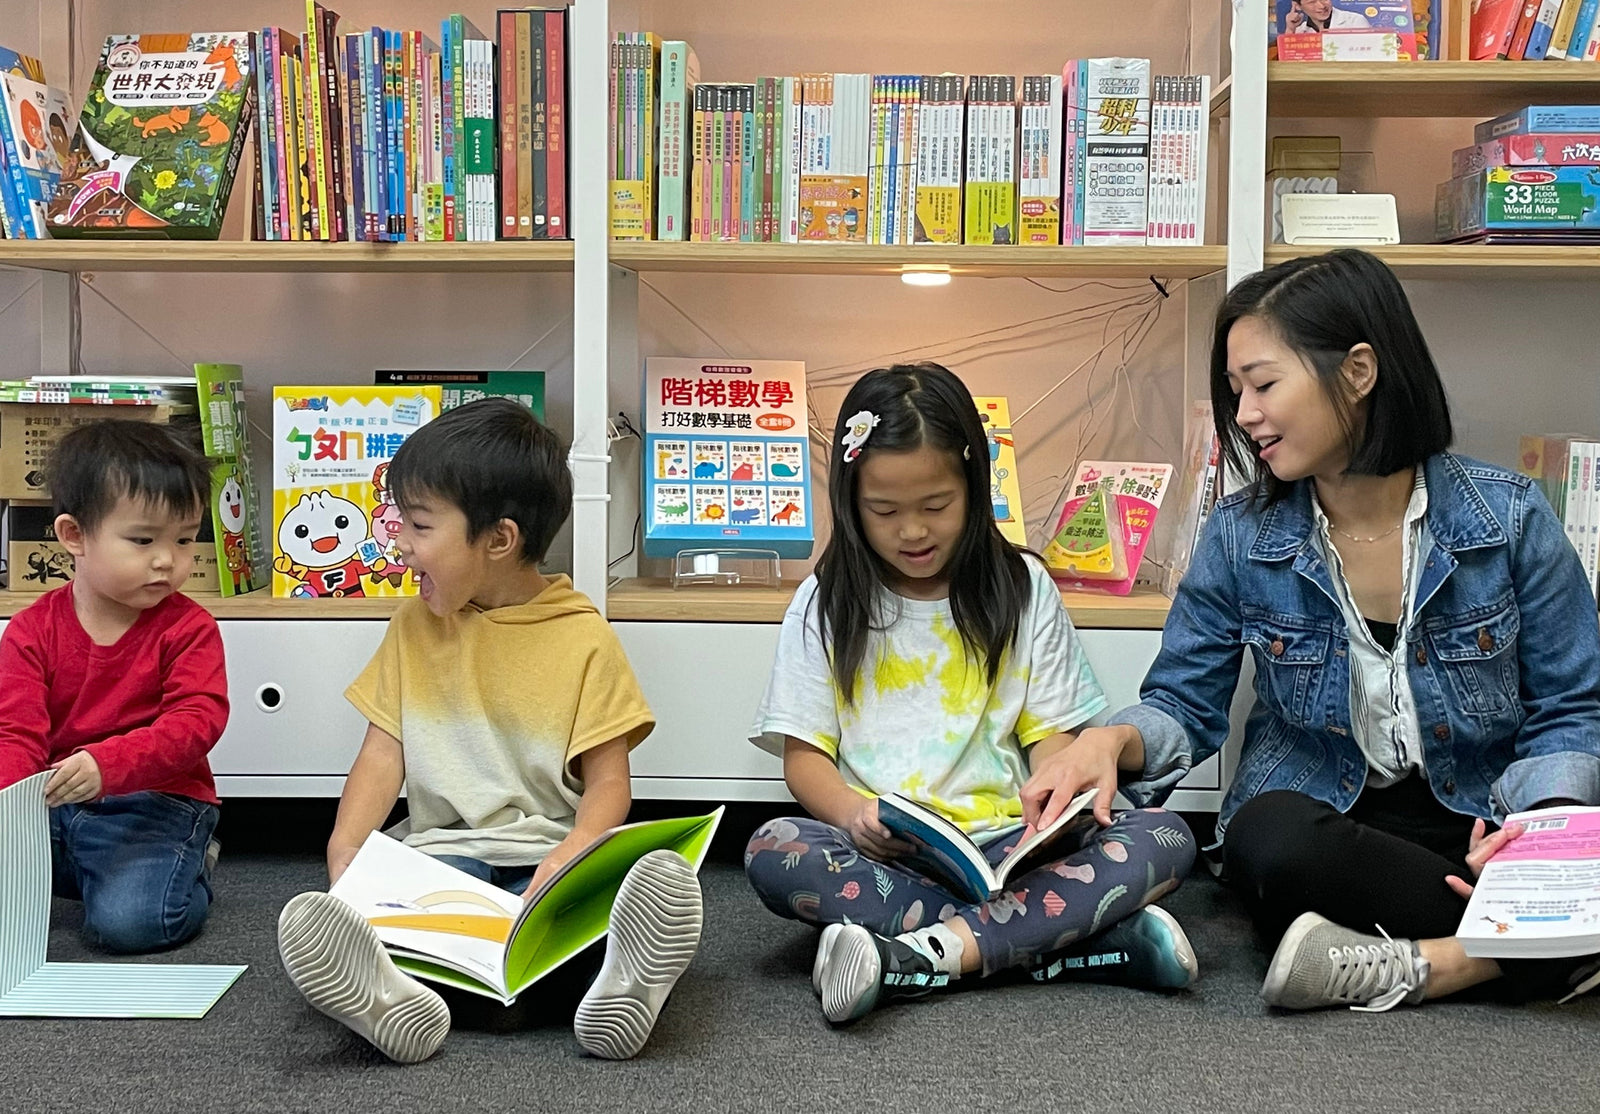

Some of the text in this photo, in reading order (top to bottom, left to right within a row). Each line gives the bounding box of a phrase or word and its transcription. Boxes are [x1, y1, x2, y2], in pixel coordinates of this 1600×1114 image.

[139, 60, 199, 70] 你不知道的
[112, 72, 217, 91] 世界大發現
[1099, 98, 1138, 117] 超科
[1099, 117, 1138, 136] 少年
[1504, 185, 1532, 204] 33
[1503, 205, 1558, 215] World Map
[661, 377, 794, 408] 階梯數學
[319, 416, 388, 427] 新版兒童正音
[661, 411, 752, 429] 打好數學基礎
[286, 426, 407, 461] ㄅㄆㄇ拼音
[323, 570, 345, 589] F
[1065, 957, 1085, 968] NIKE
